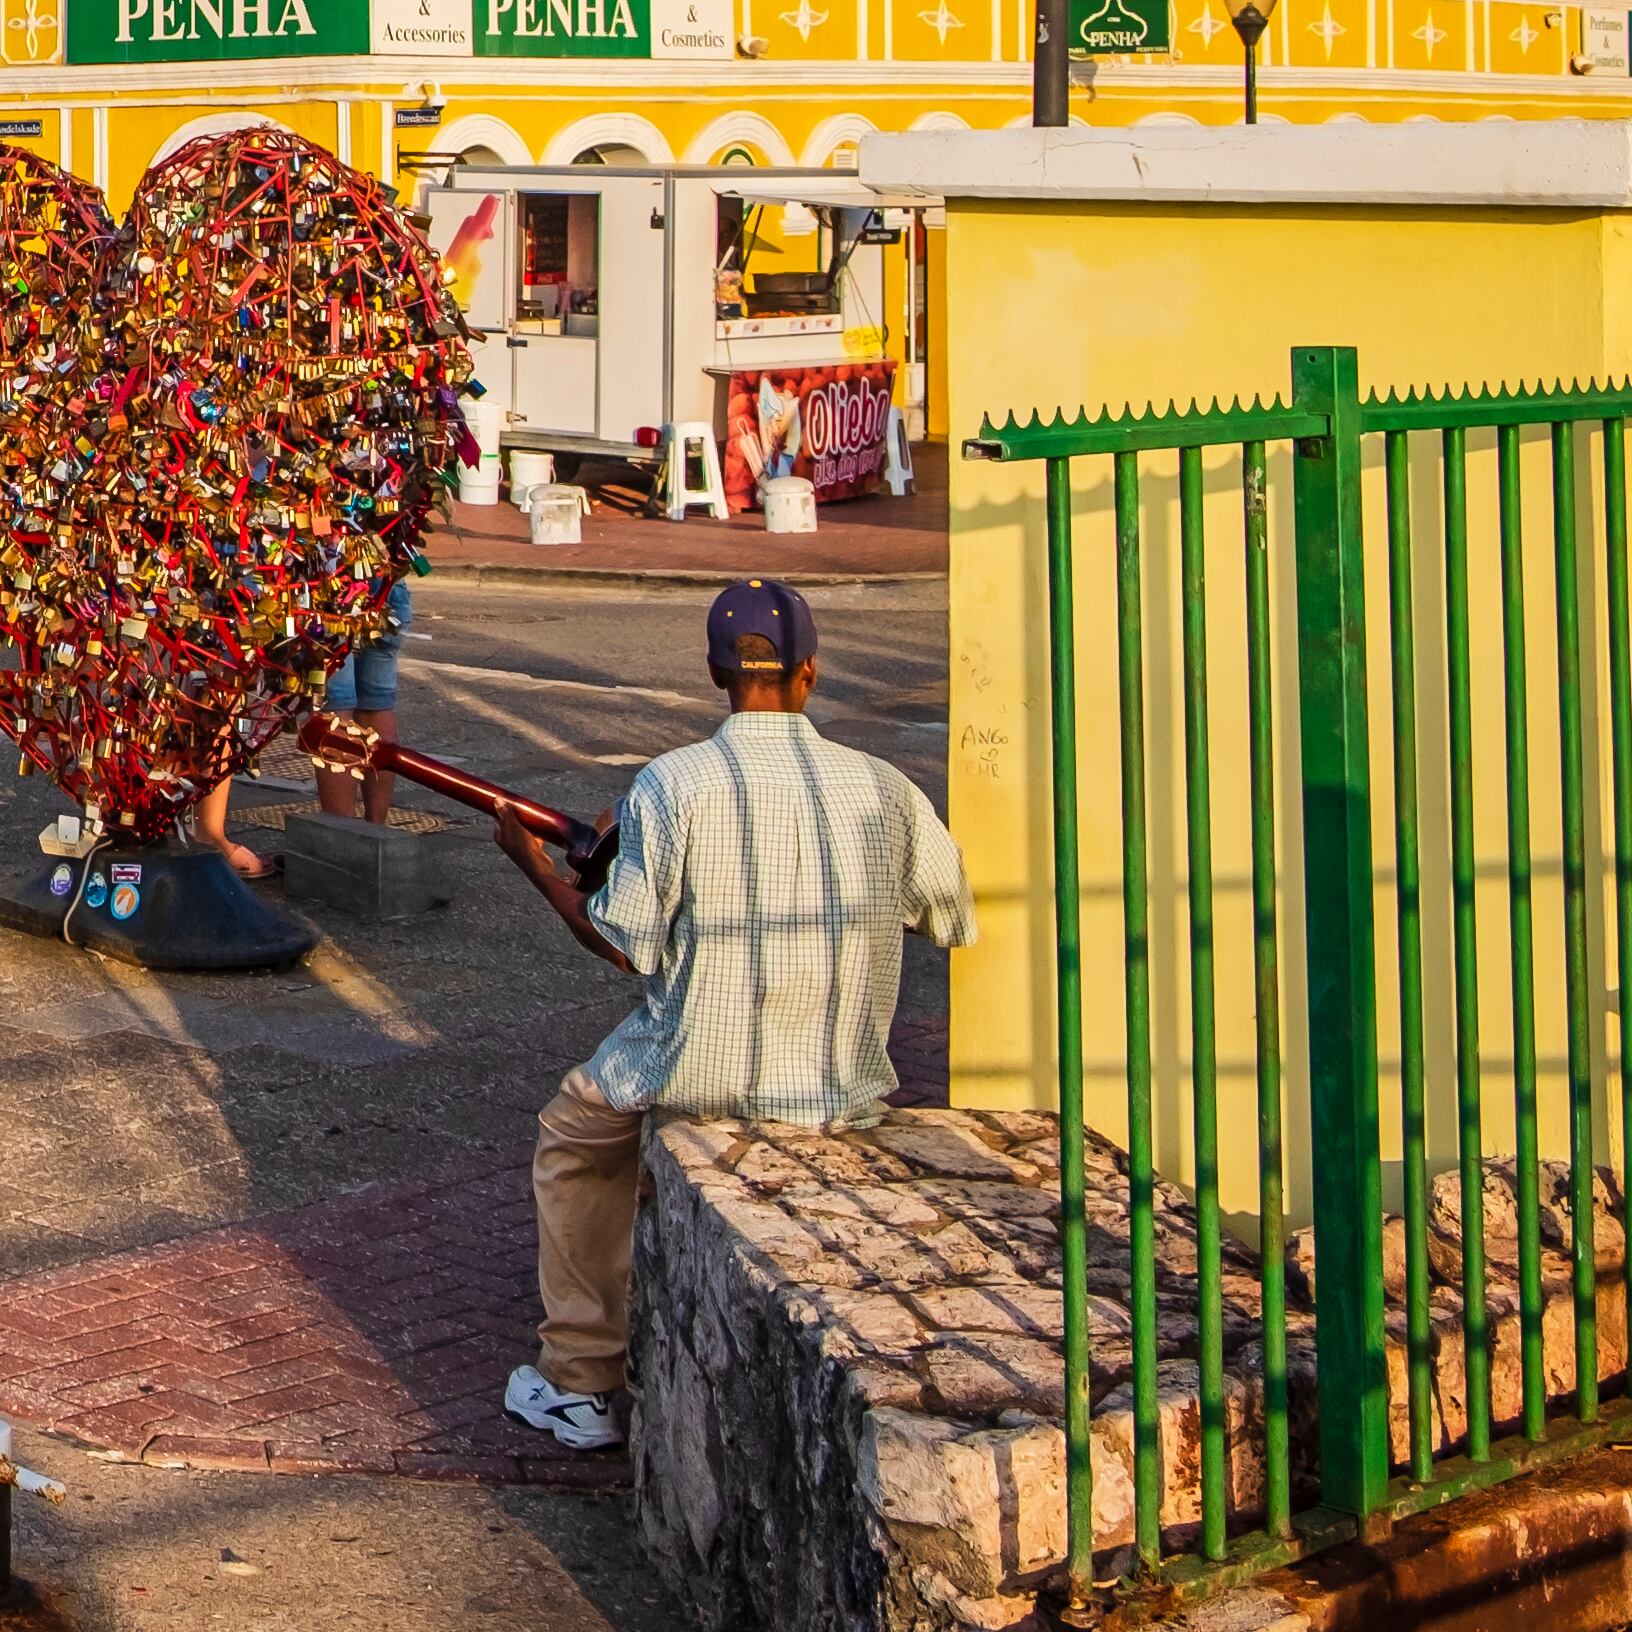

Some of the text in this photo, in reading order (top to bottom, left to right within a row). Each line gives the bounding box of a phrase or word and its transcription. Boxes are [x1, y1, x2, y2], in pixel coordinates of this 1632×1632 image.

[687, 4, 698, 23] &
[382, 21, 466, 45] Accessories
[661, 28, 725, 48] Cosmetics
[1089, 31, 1141, 47] PENHA
